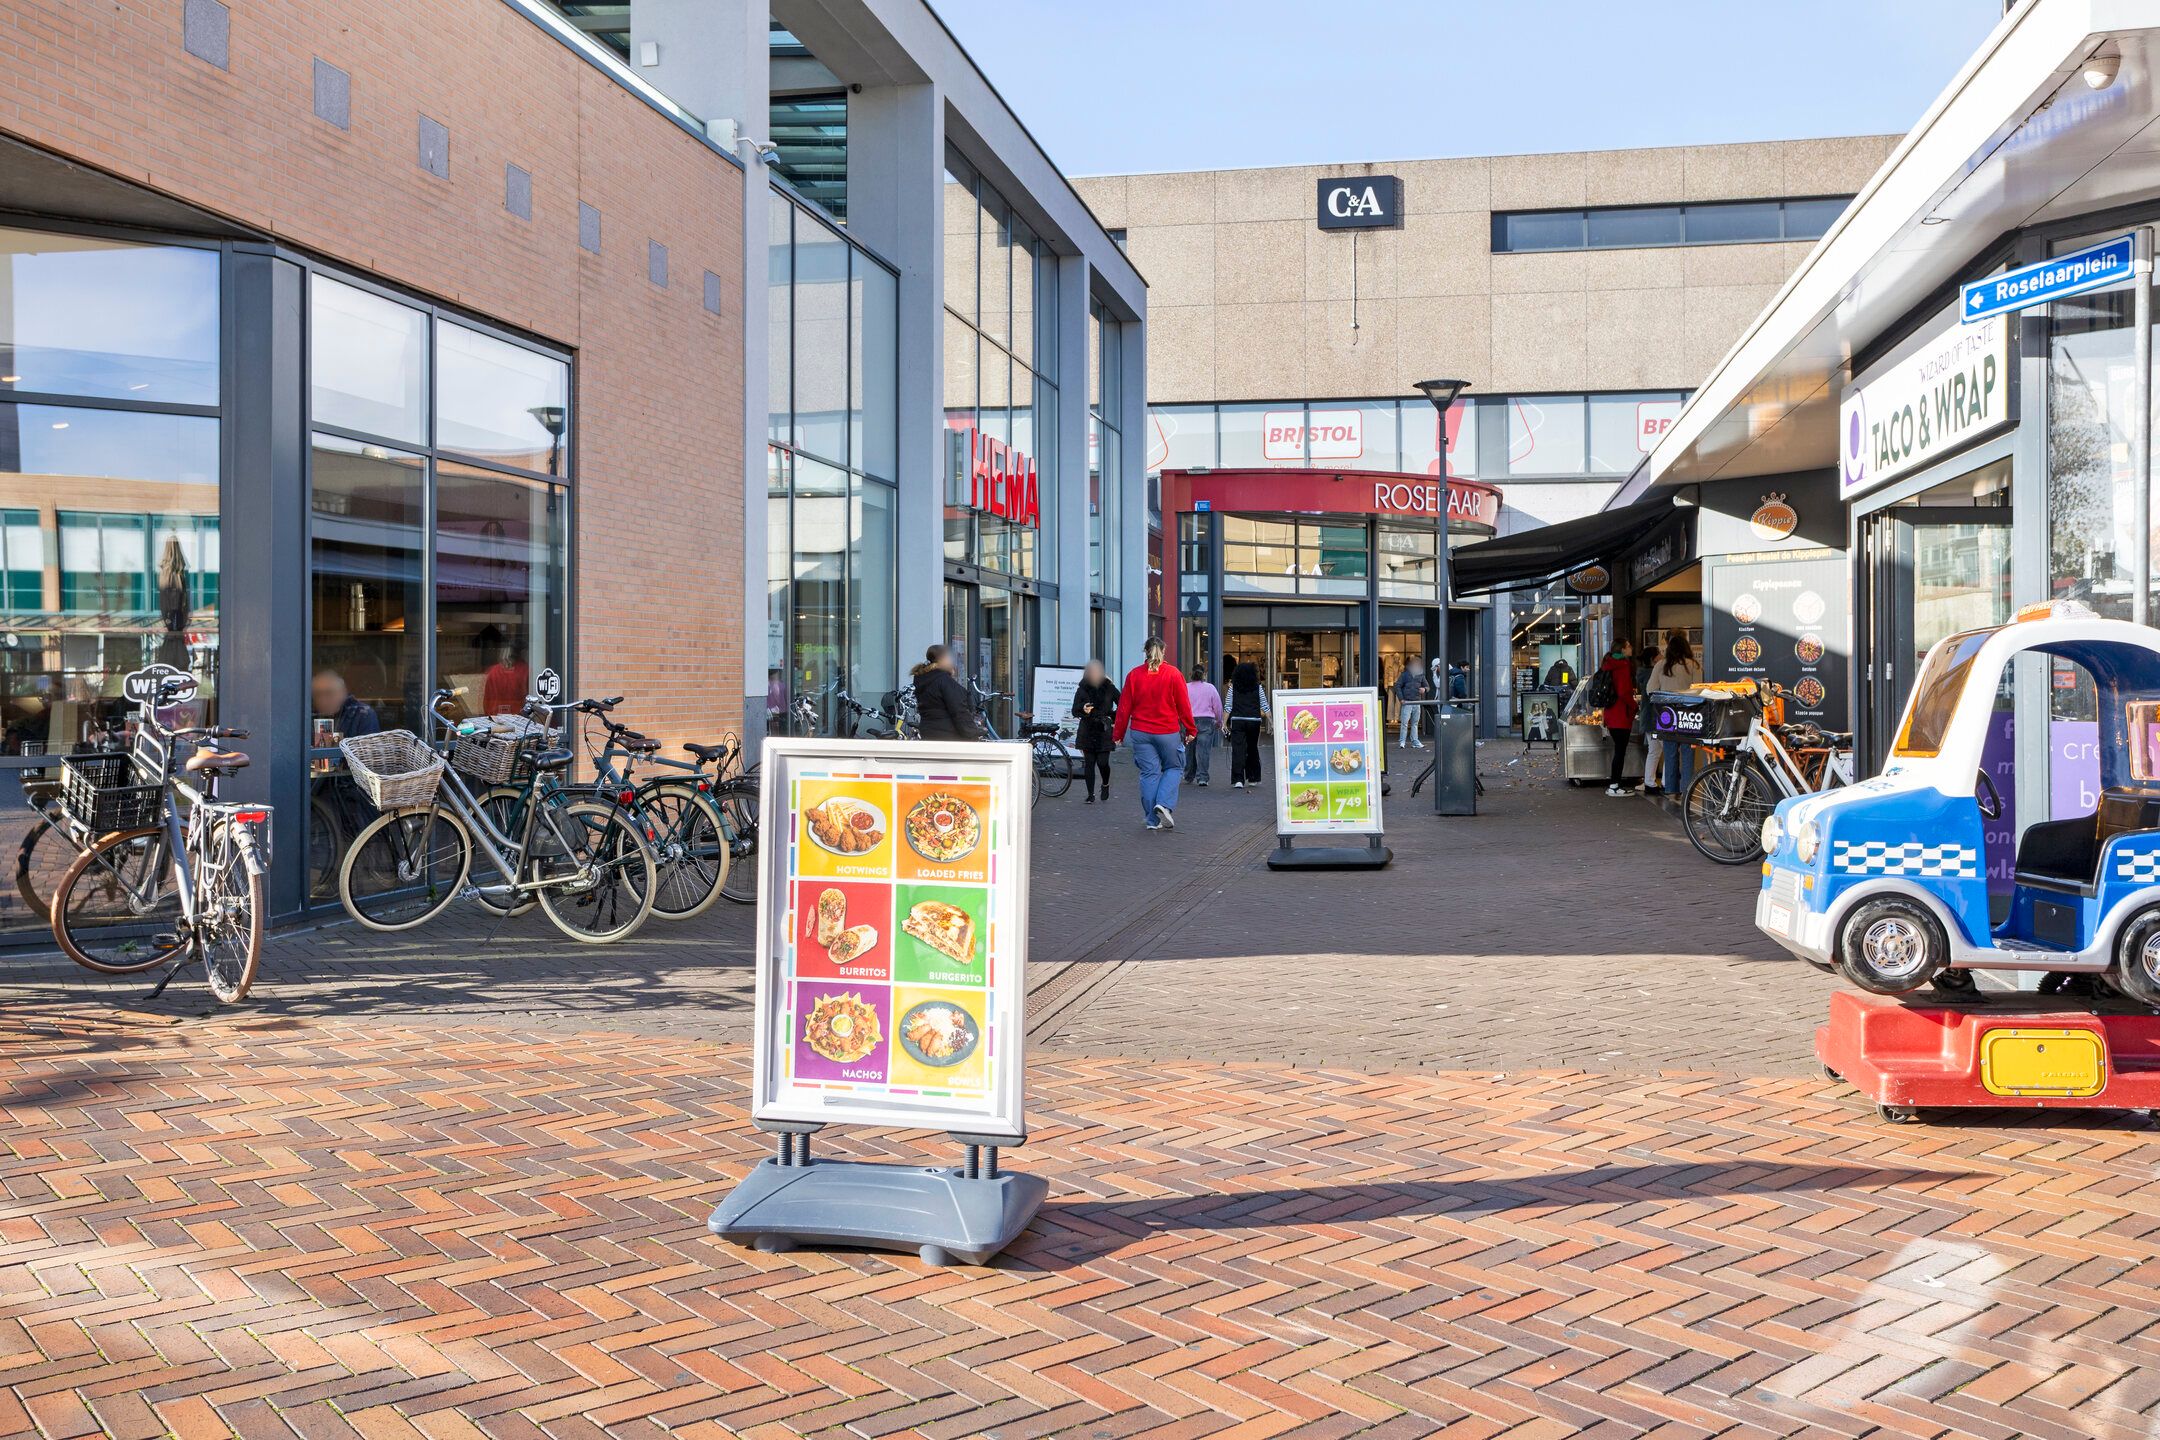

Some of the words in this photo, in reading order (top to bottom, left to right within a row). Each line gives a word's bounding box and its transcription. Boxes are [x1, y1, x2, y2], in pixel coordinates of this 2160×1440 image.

[1327, 186, 1384, 217] C&A
[1996, 251, 2118, 302] Roselaarplein
[1919, 351, 1950, 384] WIZARD
[1952, 341, 1963, 365] OF
[1872, 403, 1913, 471] TACO
[1919, 394, 1931, 450] &
[1934, 353, 1996, 436] WRAP
[971, 427, 1041, 530] HEMA
[1757, 512, 1793, 530] Kippie
[1571, 571, 1606, 585] Kippie
[151, 667, 170, 675] Free
[1333, 710, 1356, 718] TACO
[1677, 710, 1704, 723] TACO
[1677, 721, 1704, 731] &WRAP
[836, 864, 888, 877] HOTWINGS
[917, 868, 956, 879] LOADED
[957, 870, 984, 881] FRIES
[839, 966, 887, 978] BURRITOS
[928, 971, 983, 983] BURGERITO
[842, 1068, 883, 1081] NACHOS
